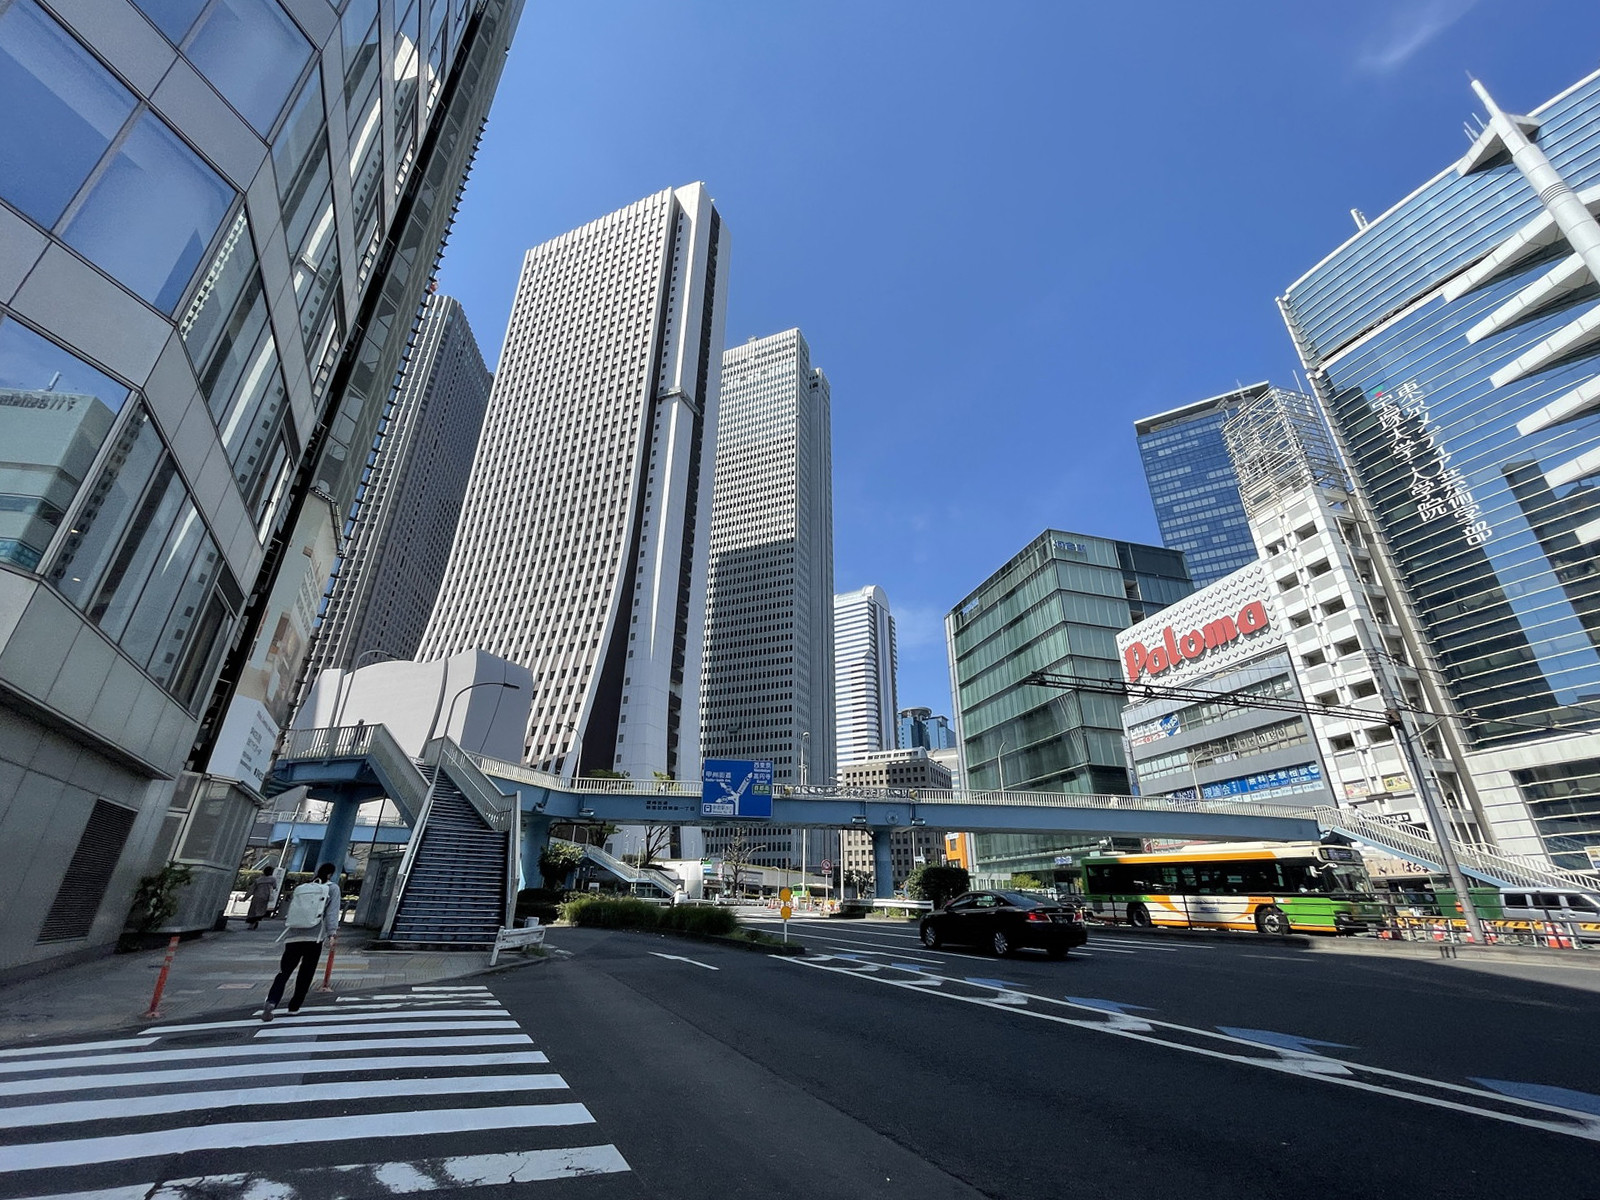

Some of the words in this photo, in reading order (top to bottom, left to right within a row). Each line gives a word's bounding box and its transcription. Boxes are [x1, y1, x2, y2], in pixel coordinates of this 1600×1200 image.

[1397, 379, 1492, 546] 東京メディア芸術学部
[1124, 600, 1269, 682] Paloma
[705, 771, 732, 779] 甲州街道
